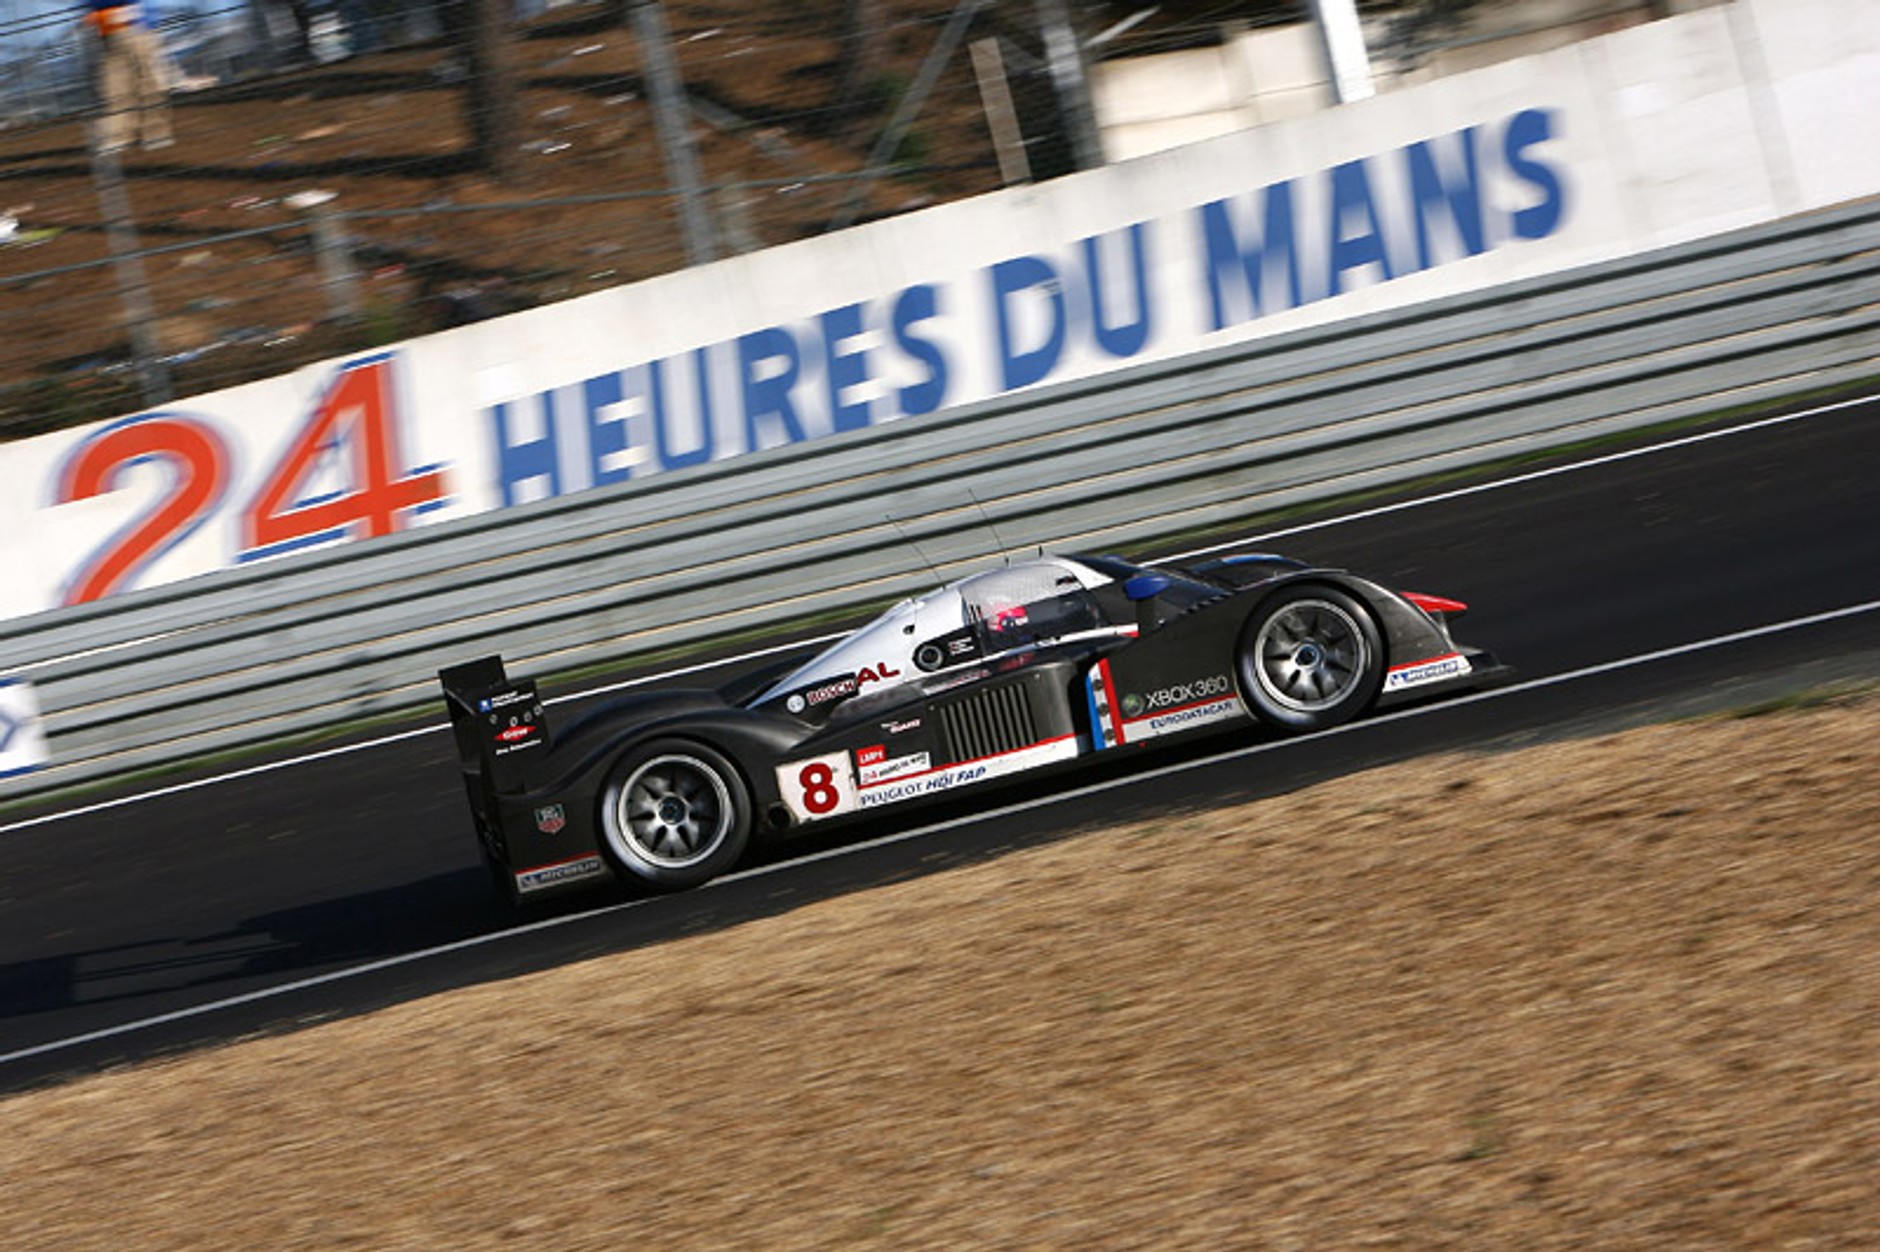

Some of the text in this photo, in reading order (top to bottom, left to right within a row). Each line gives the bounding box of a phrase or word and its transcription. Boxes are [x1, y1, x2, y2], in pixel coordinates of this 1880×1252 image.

[50, 106, 1566, 608] 24 HEURES DU MANS
[806, 680, 855, 706] BOSCH
[1145, 674, 1229, 709] XBOX 360
[799, 762, 840, 814] 8
[860, 781, 922, 806] PEUGEOT
[956, 765, 987, 783] FAP
